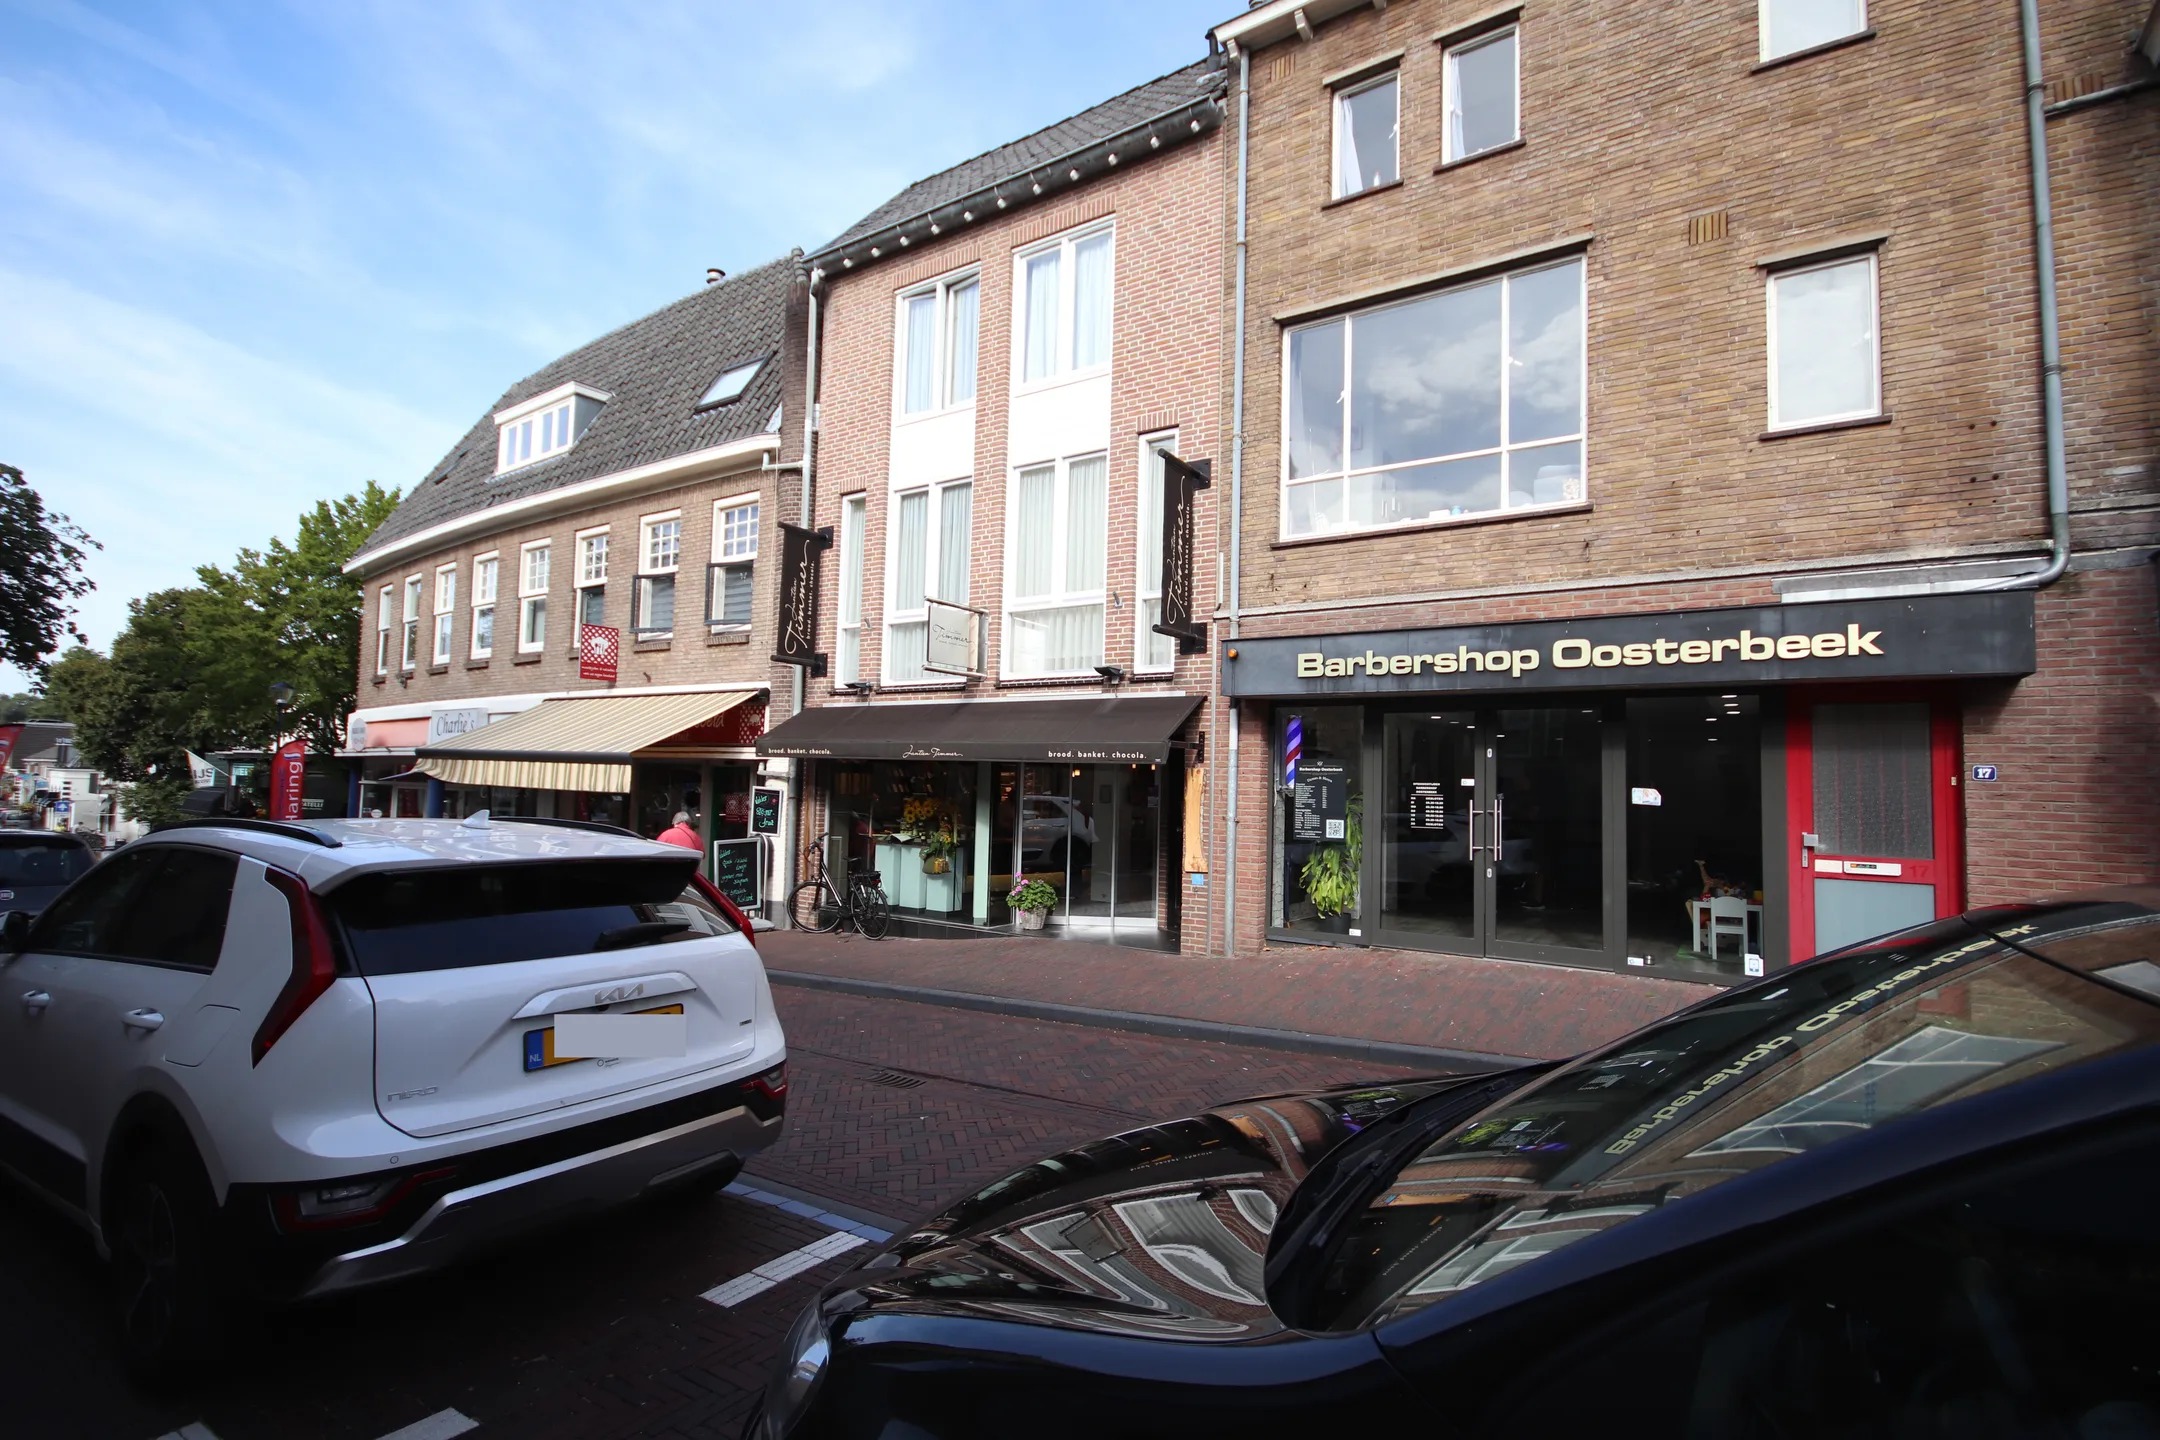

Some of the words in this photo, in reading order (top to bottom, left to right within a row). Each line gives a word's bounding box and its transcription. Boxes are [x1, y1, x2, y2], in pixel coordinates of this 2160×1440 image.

[1167, 475, 1186, 624] Timmer
[784, 540, 810, 654] Timmer
[932, 623, 977, 647] Timmer
[1297, 645, 1540, 678] Barbershop
[1552, 624, 1885, 669] Oosterbeek
[436, 712, 475, 736] Charlie's
[931, 747, 964, 758] Timmer
[1048, 750, 1075, 758] brood.
[1112, 751, 1147, 759] chocola.
[193, 768, 213, 779] IJS
[1976, 768, 1992, 779] 17
[1909, 865, 1929, 878] 17
[595, 983, 643, 1005] KIA
[529, 1053, 542, 1062] NL
